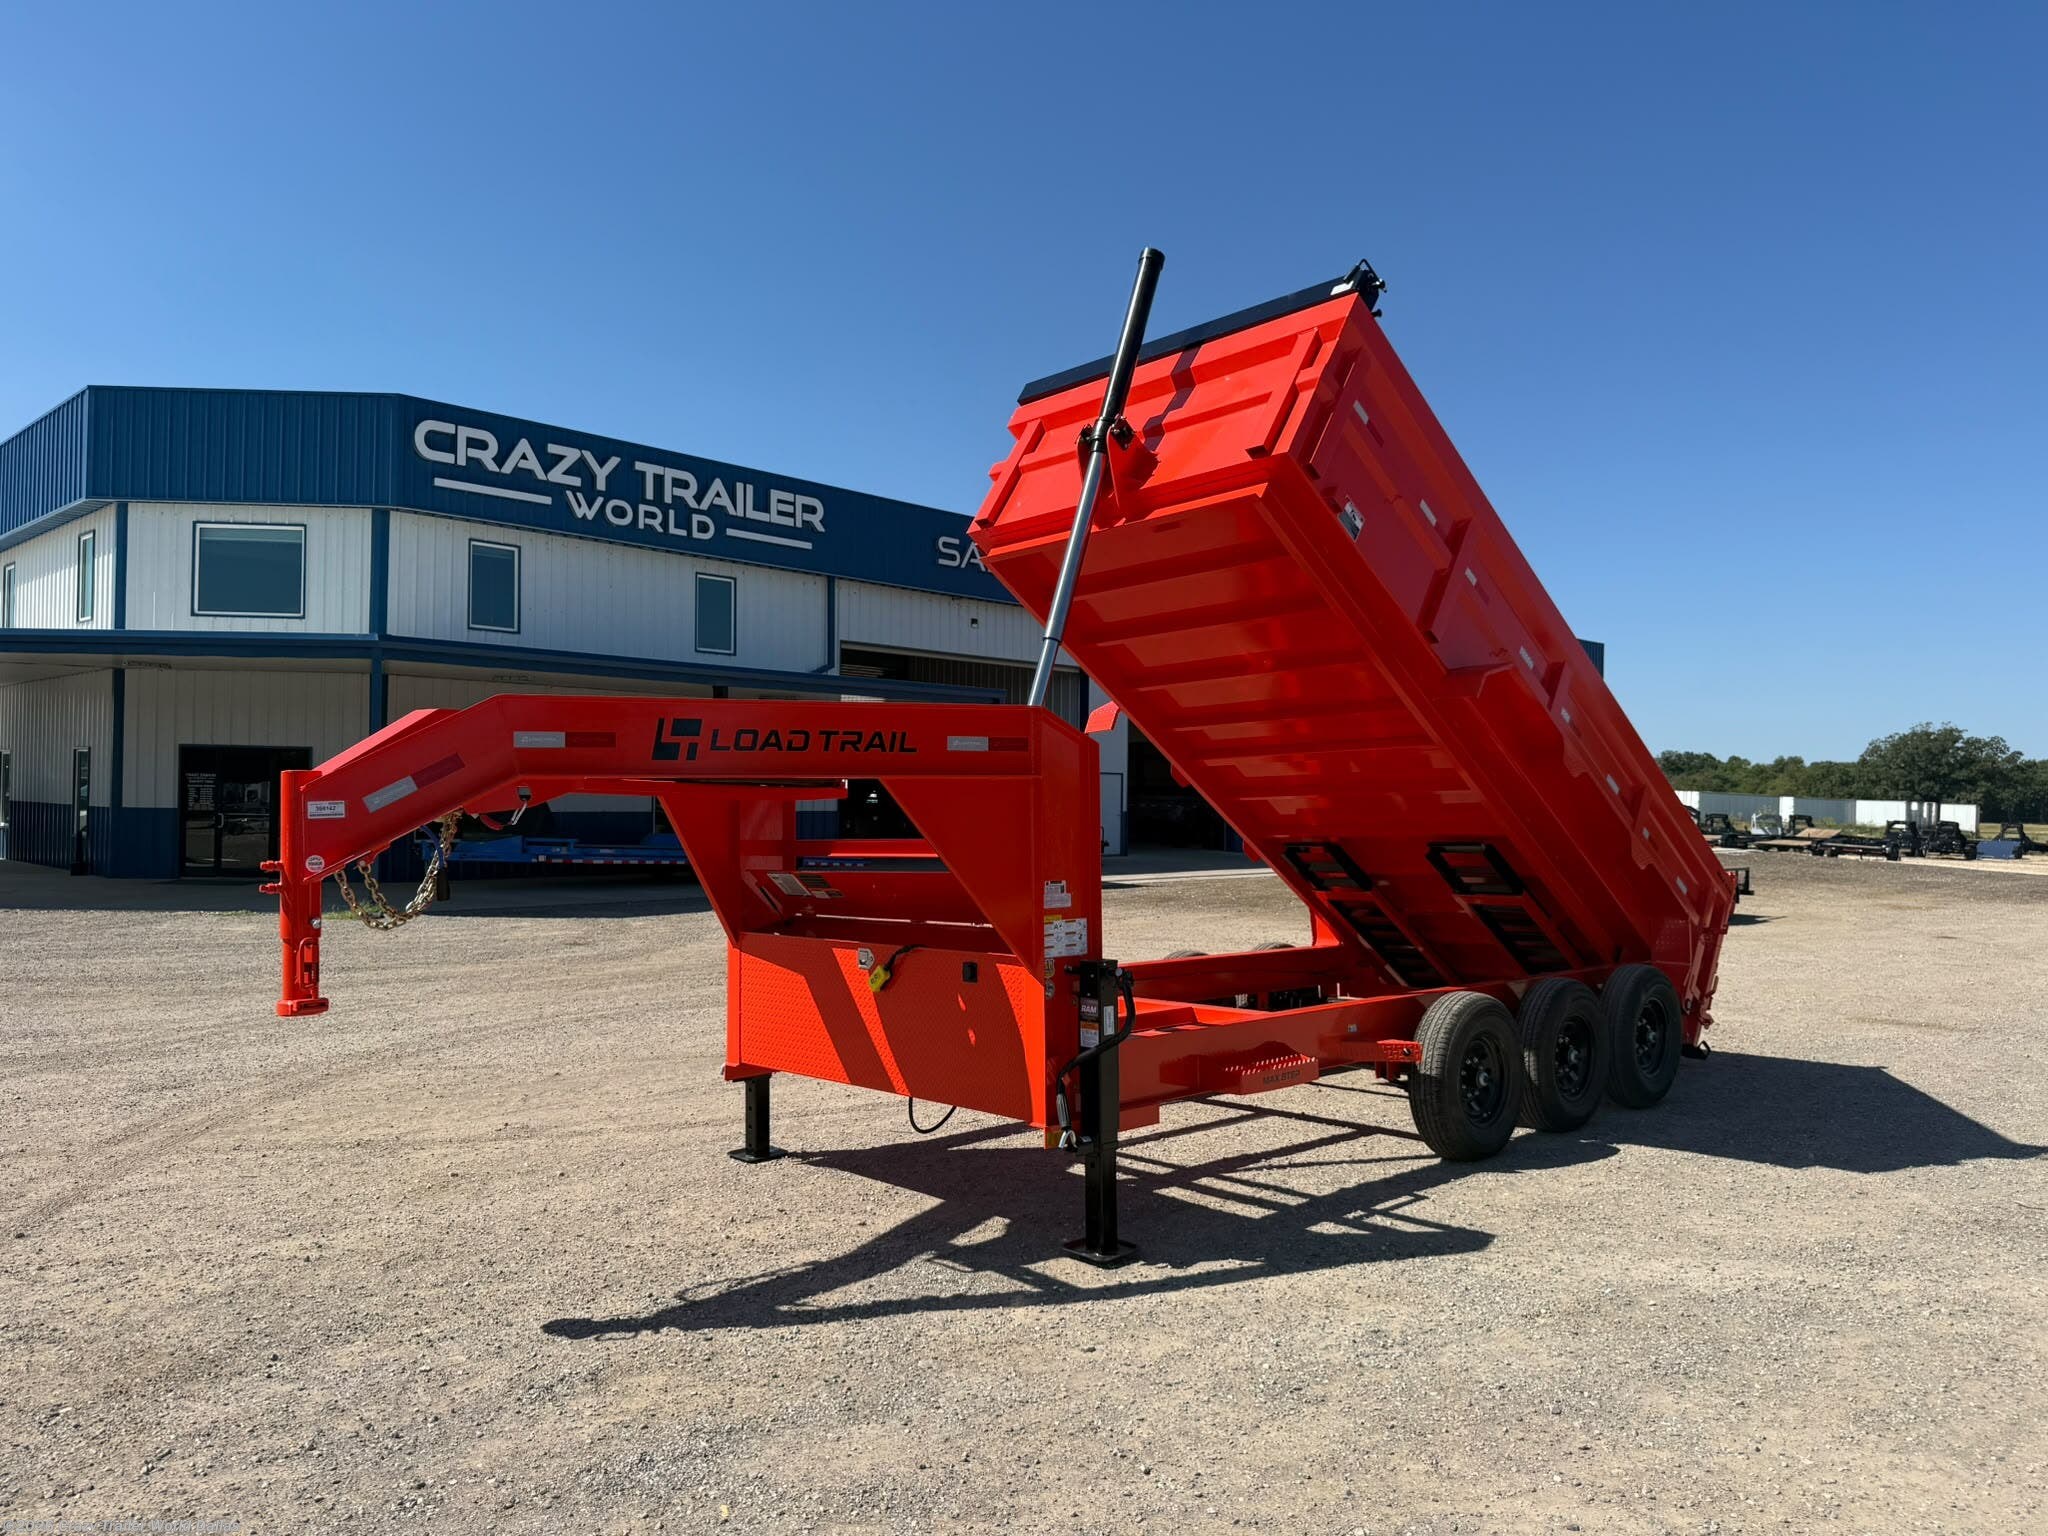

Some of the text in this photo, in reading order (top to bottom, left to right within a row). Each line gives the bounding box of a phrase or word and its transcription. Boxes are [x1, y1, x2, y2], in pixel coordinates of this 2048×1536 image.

[414, 419, 826, 533] CRAZY TRAILER
[565, 489, 716, 541] WORLD
[937, 535, 993, 573] SA
[710, 728, 918, 753] LOAD TRAIL
[1081, 1004, 1097, 1014] RAM
